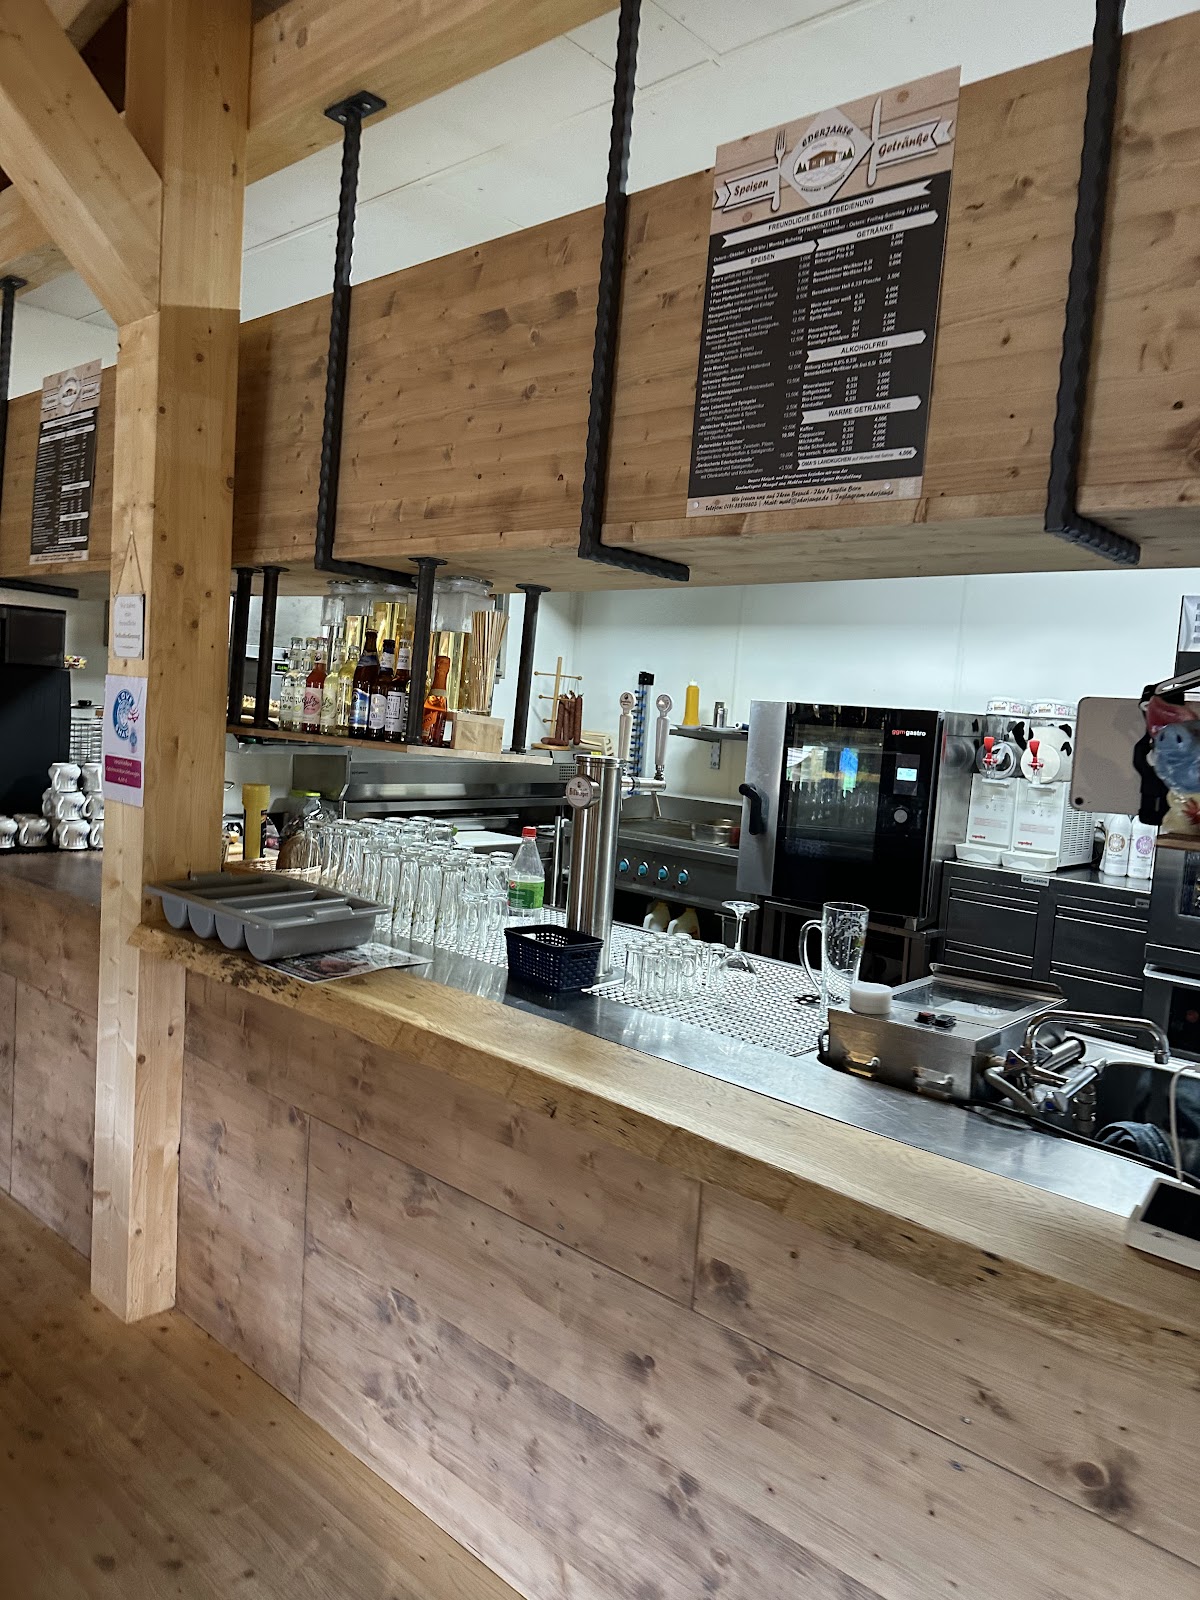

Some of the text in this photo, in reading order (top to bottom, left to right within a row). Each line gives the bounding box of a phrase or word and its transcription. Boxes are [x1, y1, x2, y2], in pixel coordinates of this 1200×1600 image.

[878, 130, 930, 157] Getränke
[733, 179, 769, 198] Speisen
[768, 197, 873, 231] FREUNDLICHE SELBSTBEDIENUNG
[856, 222, 893, 238] GETRÄNKE
[750, 252, 775, 264] SPEISEN
[840, 339, 887, 354] ALKOHOLFREI
[828, 401, 891, 417] WARME GETRÄNKE
